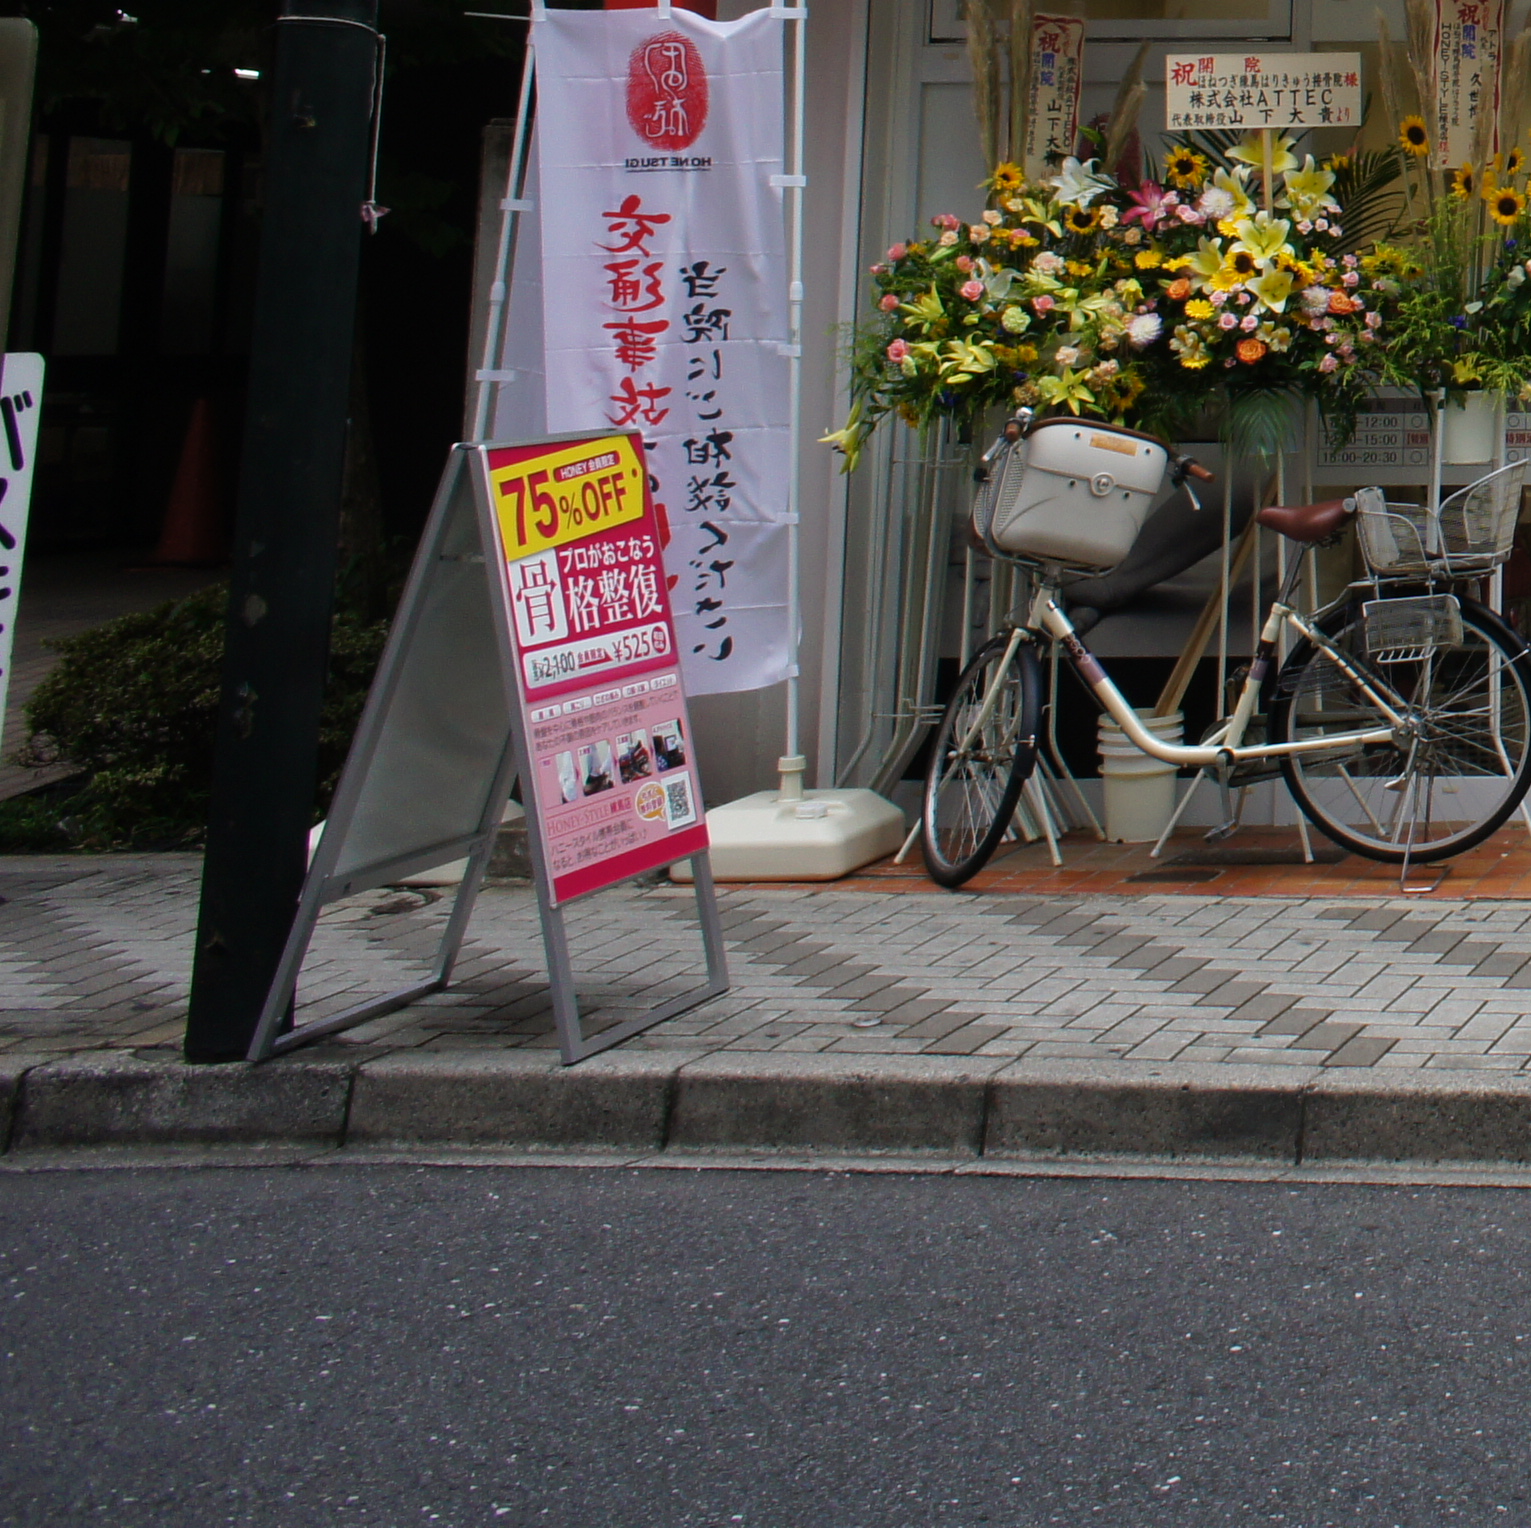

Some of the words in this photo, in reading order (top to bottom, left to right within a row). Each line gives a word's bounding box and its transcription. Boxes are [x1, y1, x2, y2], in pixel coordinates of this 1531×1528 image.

[1457, 3, 1480, 25] 祝
[1039, 30, 1061, 54] 祝
[1171, 62, 1199, 86] 祝
[559, 535, 655, 573] プロがおこなう
[516, 559, 663, 636] 骨格整復
